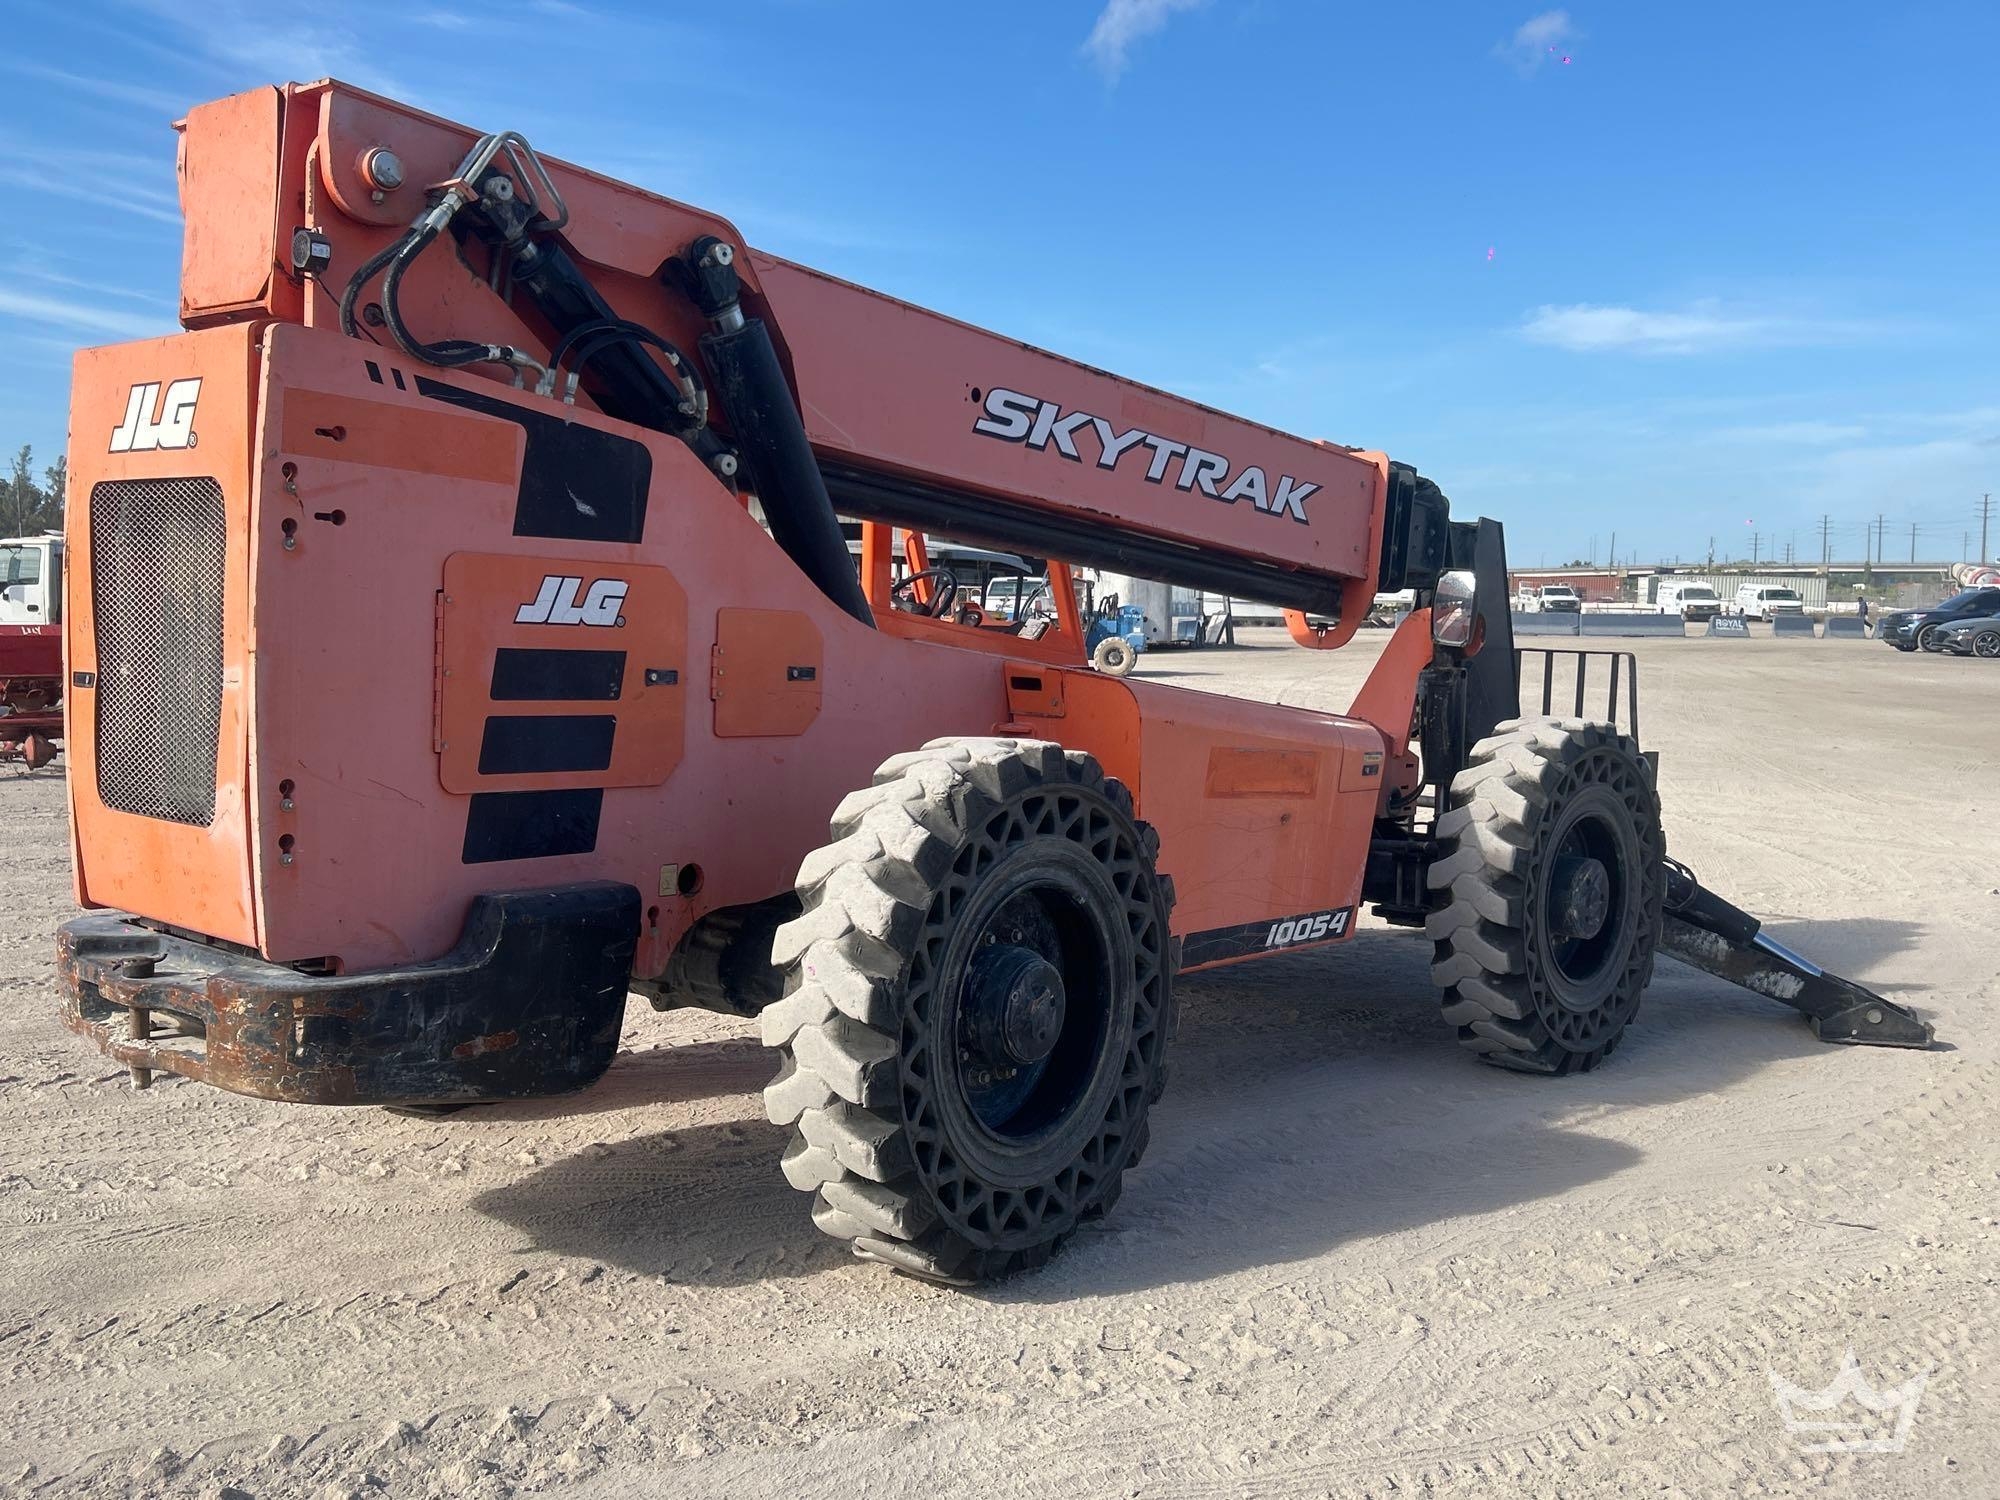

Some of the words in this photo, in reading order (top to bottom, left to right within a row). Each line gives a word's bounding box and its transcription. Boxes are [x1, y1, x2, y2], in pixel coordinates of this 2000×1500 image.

[108, 376, 203, 454] JLG
[972, 387, 1323, 525] SKYTRAK
[513, 574, 629, 627] JLG
[1715, 618, 1744, 628] ROYAL
[1265, 911, 1348, 947] 10054
